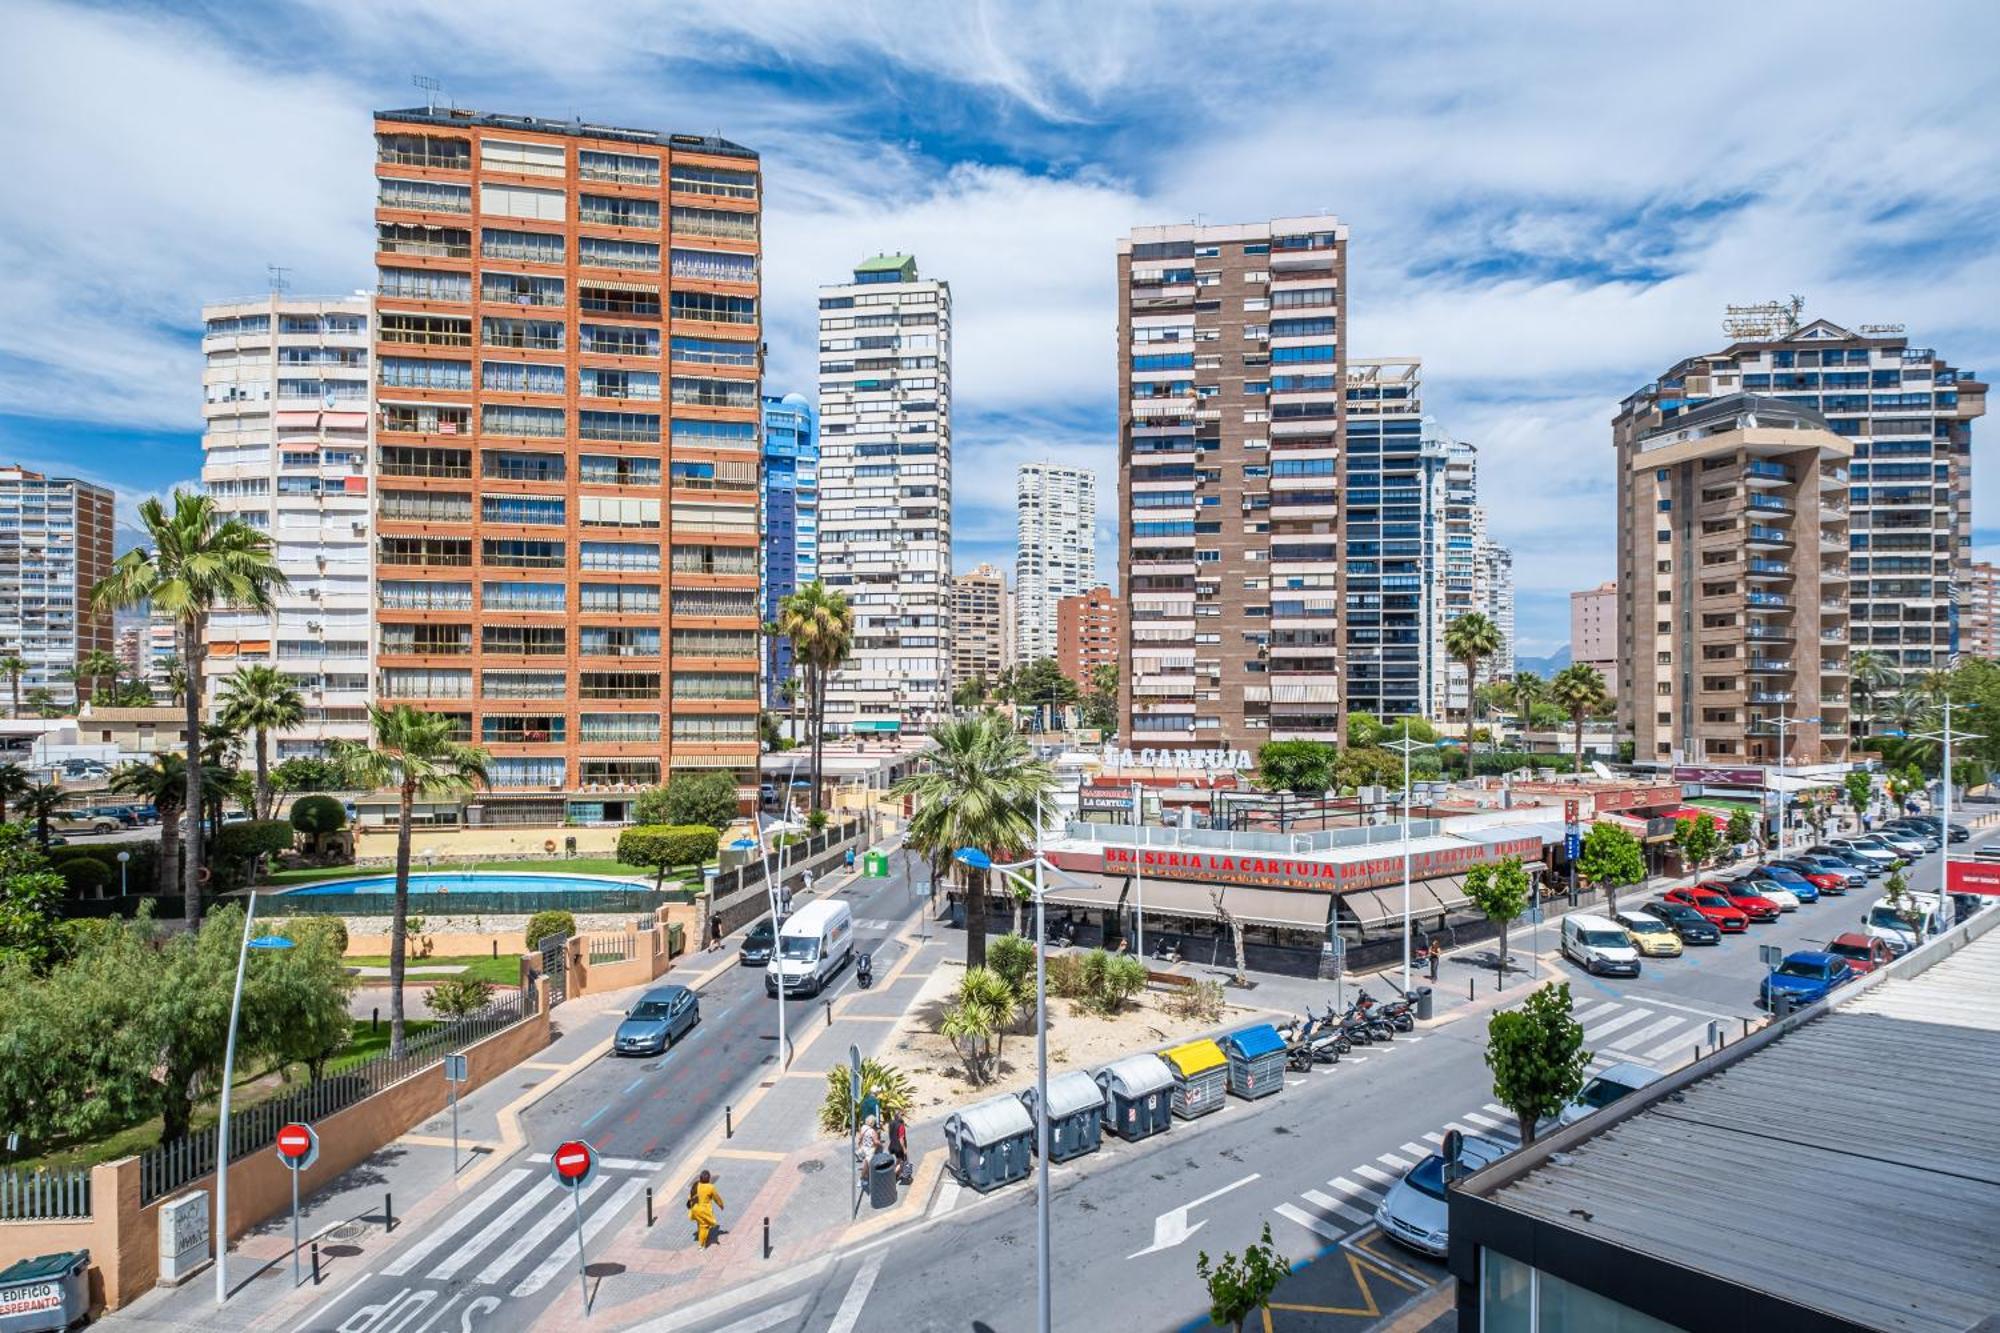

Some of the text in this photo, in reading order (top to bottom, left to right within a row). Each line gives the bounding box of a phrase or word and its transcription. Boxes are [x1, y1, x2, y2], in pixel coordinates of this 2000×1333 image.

[1104, 748, 1253, 769] LA CARTUJA
[1105, 848, 1335, 879] BRASERIA LA CARTUJA
[3, 1285, 51, 1302] EDIFICIO
